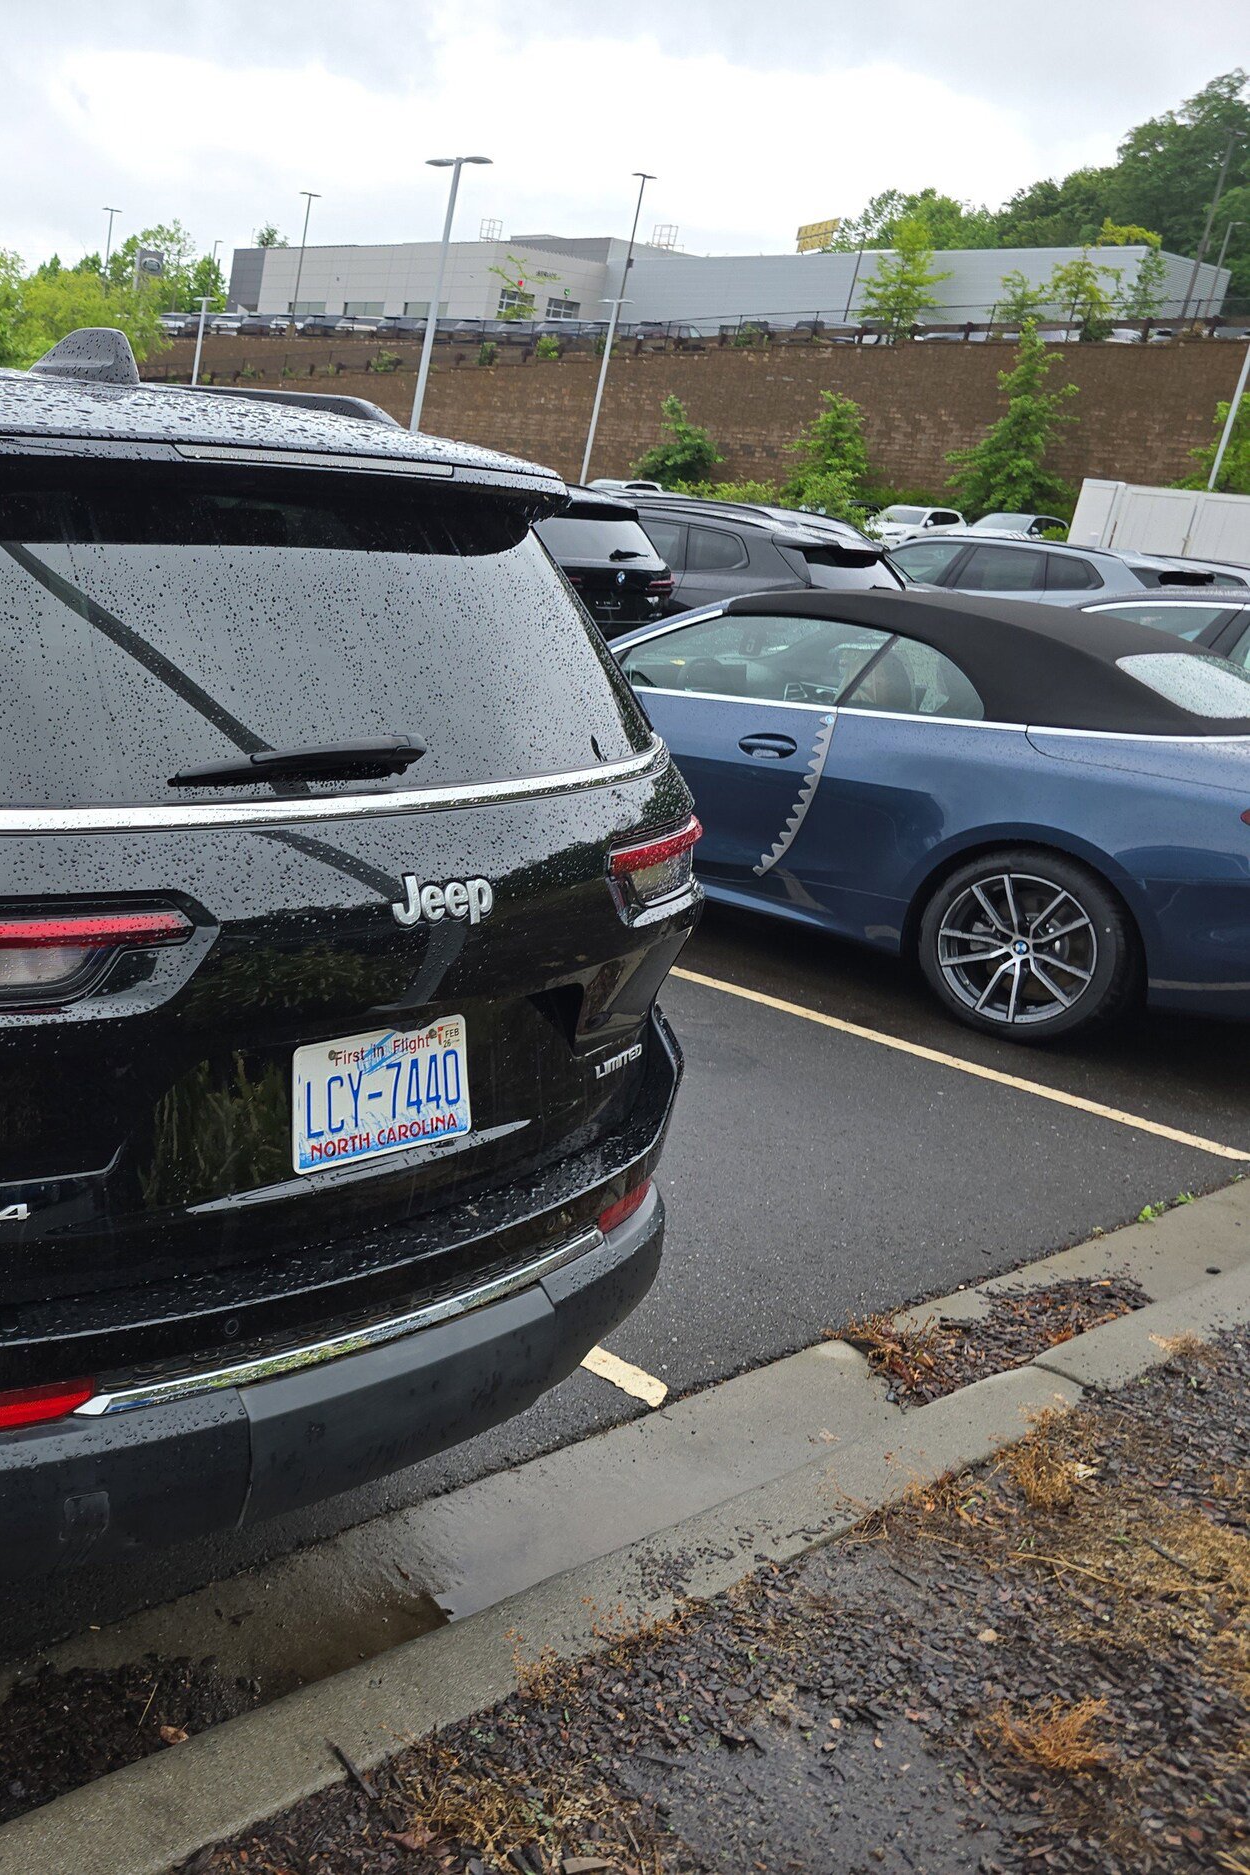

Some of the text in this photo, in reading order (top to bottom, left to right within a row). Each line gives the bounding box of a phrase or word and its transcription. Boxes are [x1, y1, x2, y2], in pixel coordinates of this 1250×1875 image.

[391, 875, 493, 925] Jeep
[335, 1034, 430, 1067] First in Flight
[445, 1028, 460, 1039] FEB
[306, 1049, 461, 1139] LCY-7440
[310, 1113, 458, 1161] NORTH CAROLINA
